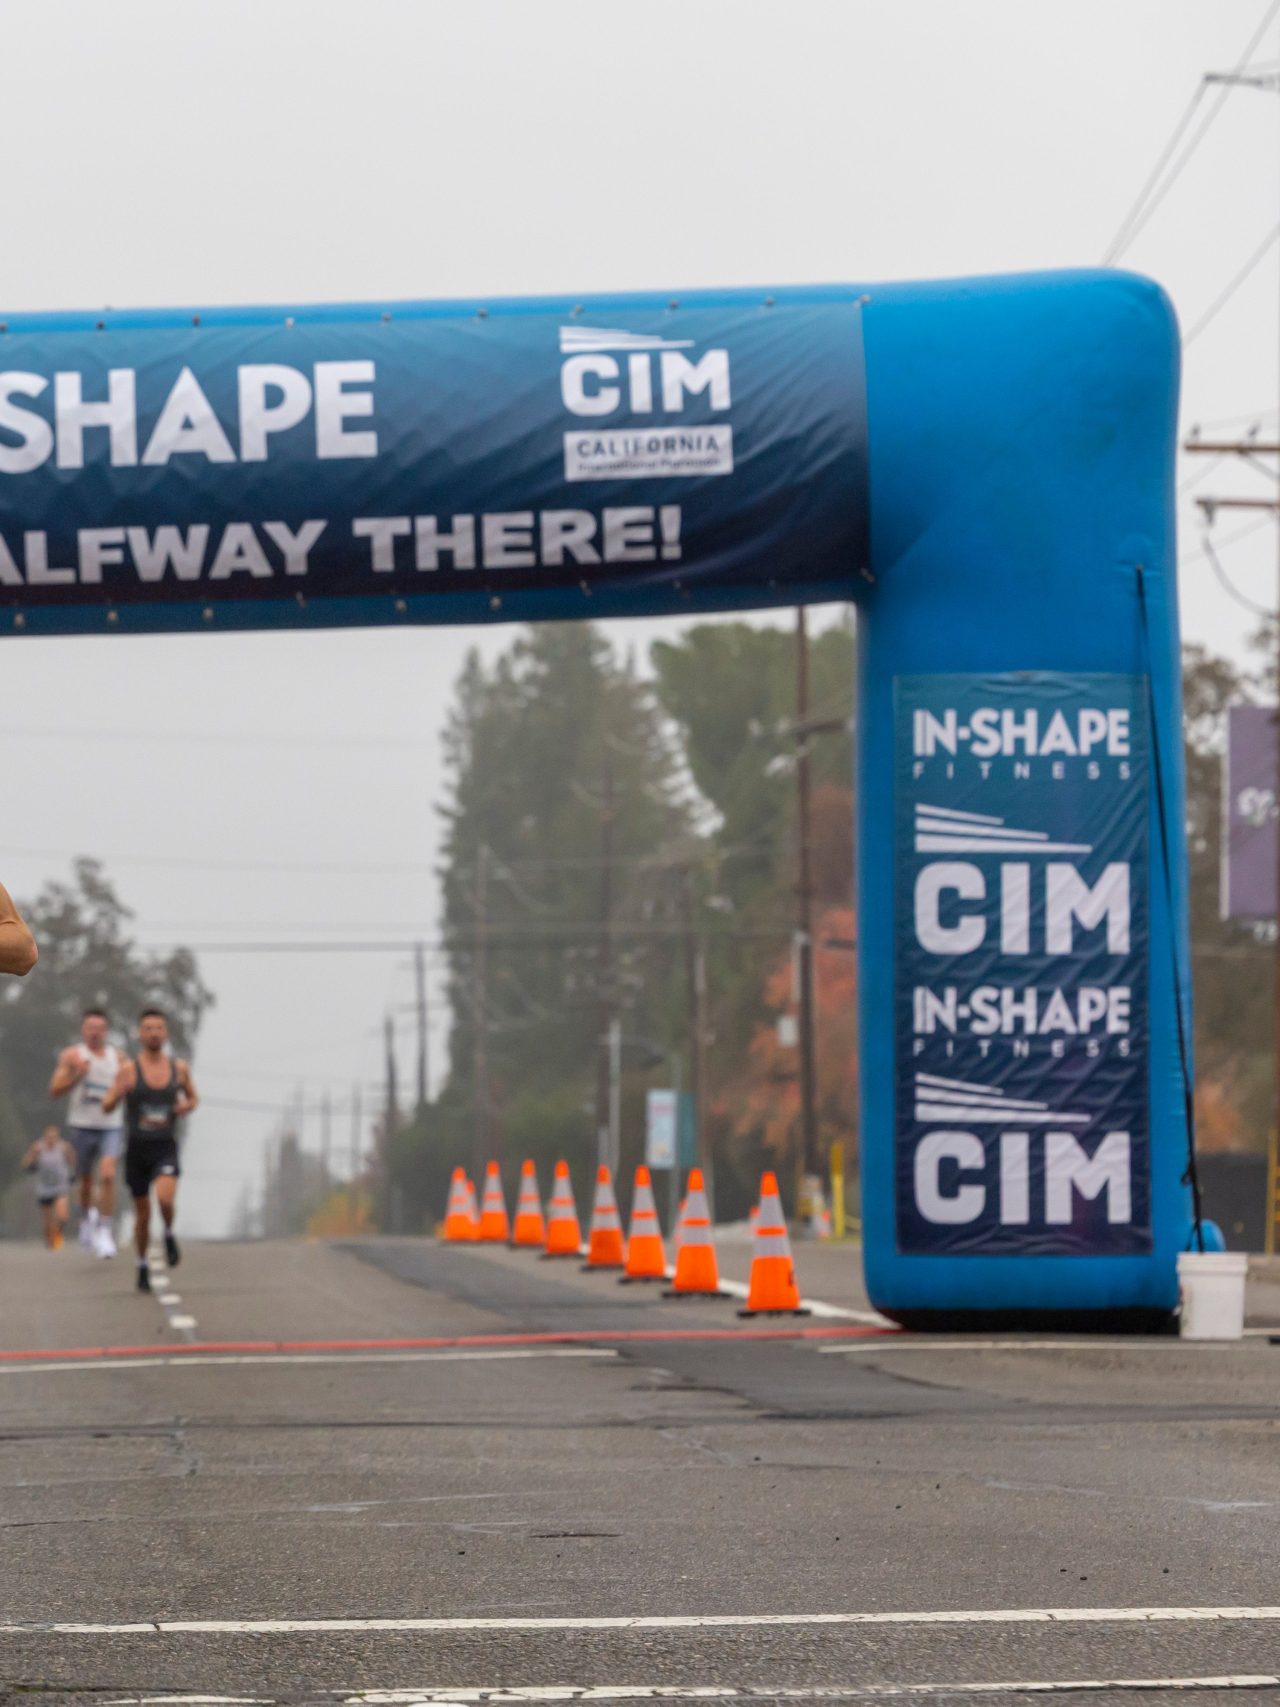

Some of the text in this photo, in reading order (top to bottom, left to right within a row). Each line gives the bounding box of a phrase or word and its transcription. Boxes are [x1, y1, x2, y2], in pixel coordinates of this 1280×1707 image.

[560, 349, 731, 416] CIM
[577, 434, 719, 458] CALIFORNIA
[352, 504, 682, 573] THERE!
[913, 707, 1130, 757] IN-SHAPE
[913, 761, 1130, 779] FITNESS
[914, 861, 1131, 955] CIM
[913, 986, 1131, 1035] IN-SHAPE
[913, 1039, 1130, 1058] FITNESS
[914, 1130, 1132, 1225] CIM
